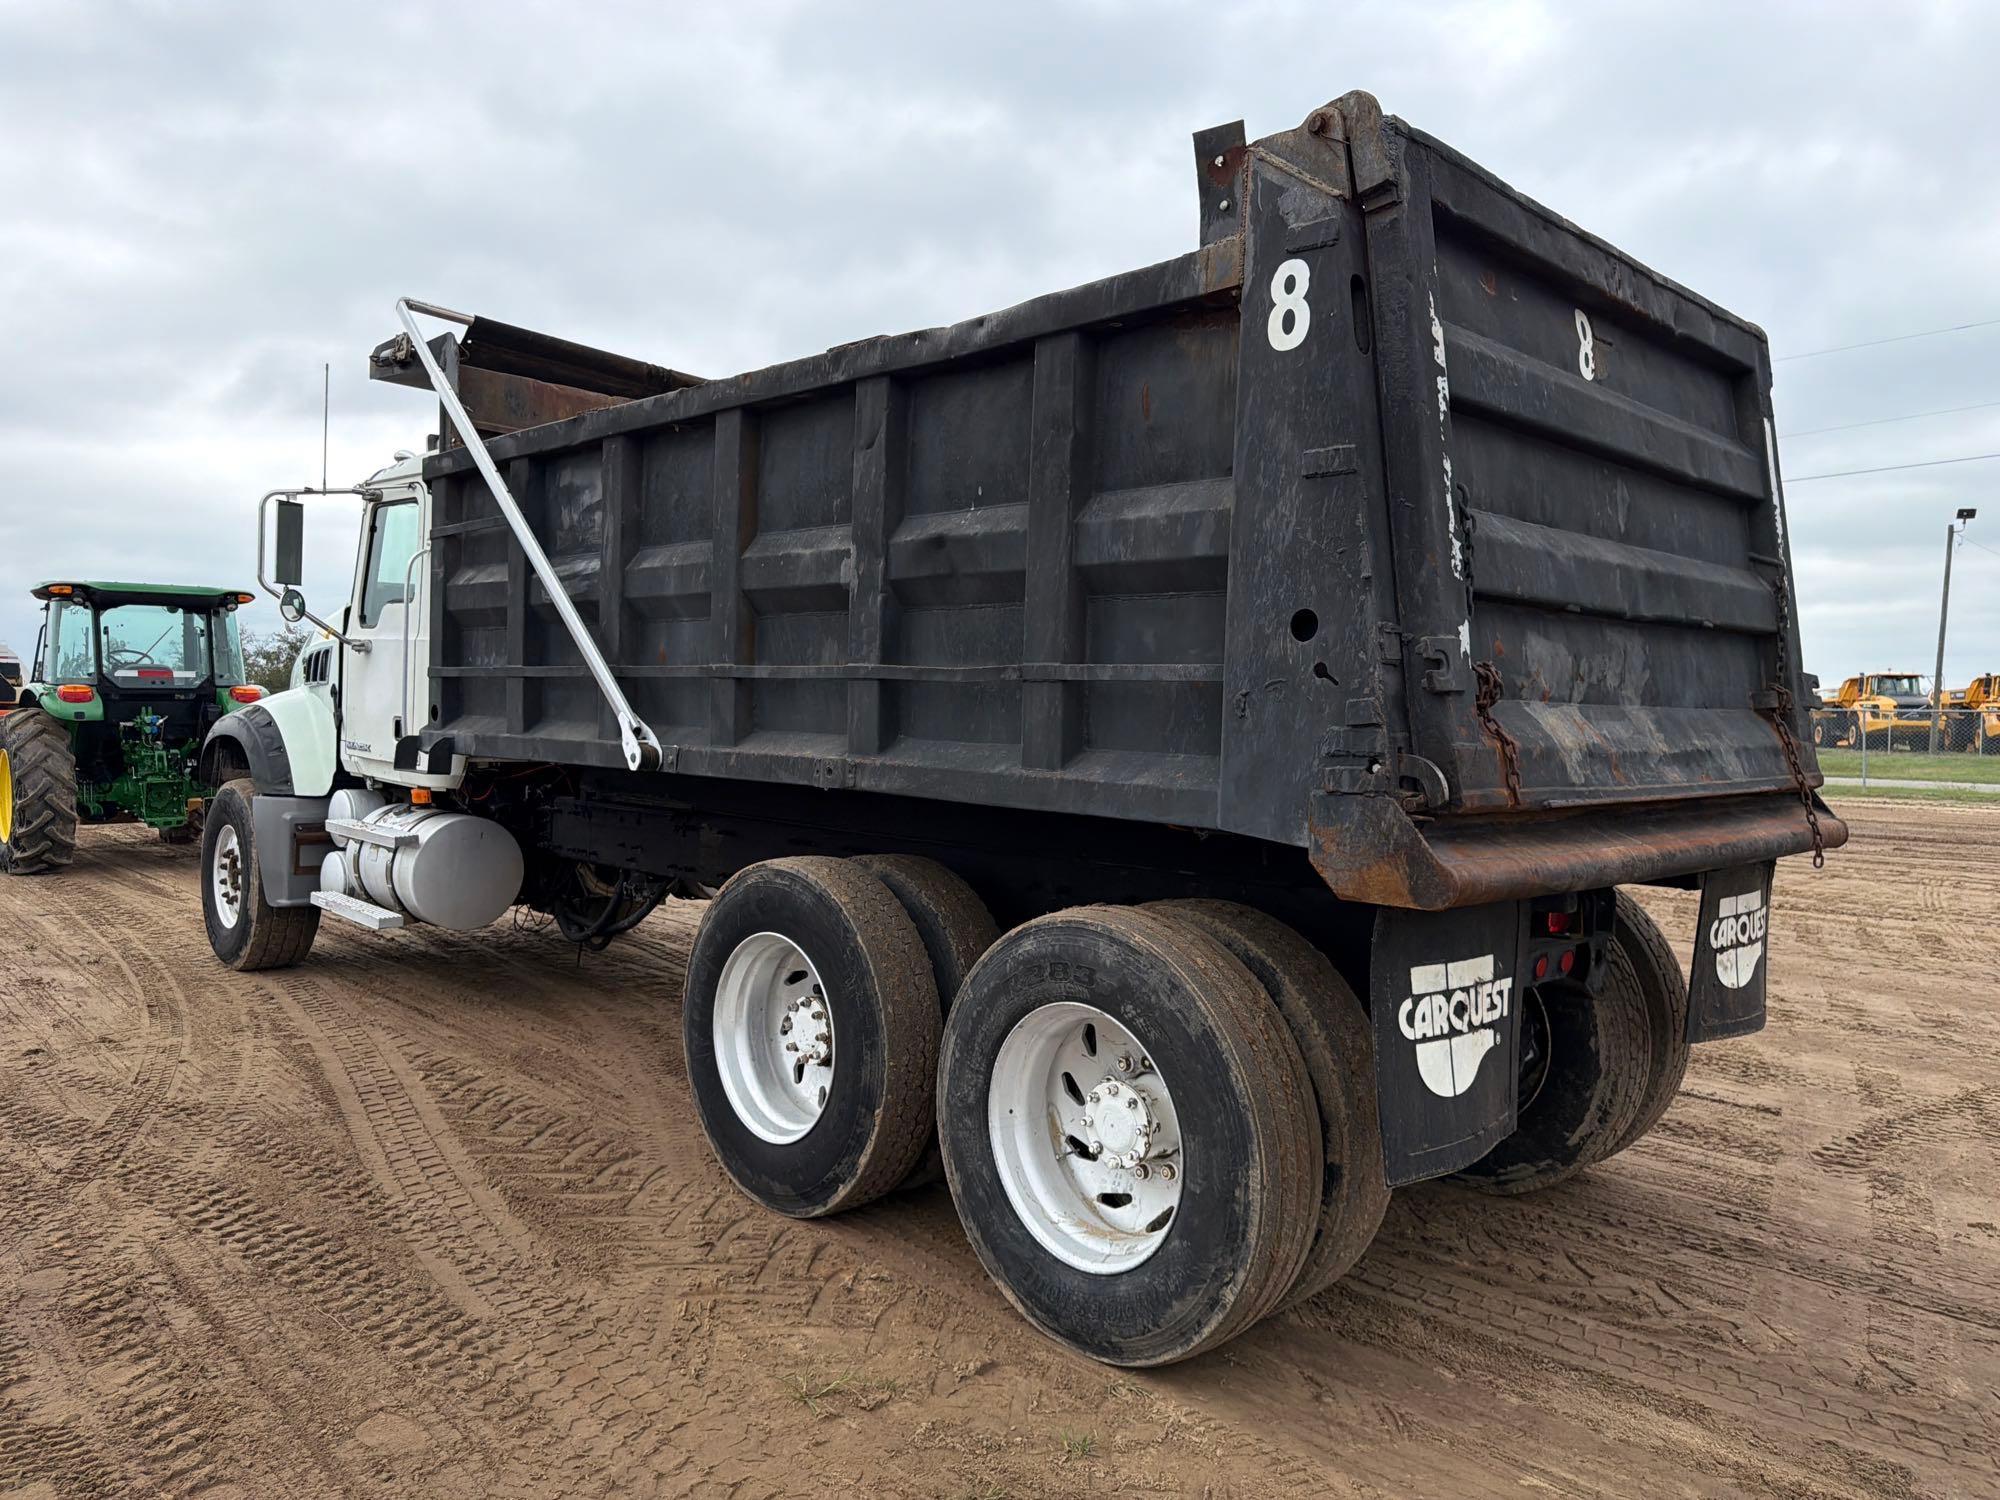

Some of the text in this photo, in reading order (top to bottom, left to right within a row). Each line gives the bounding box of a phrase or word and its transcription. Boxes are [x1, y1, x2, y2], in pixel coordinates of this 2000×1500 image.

[1267, 258, 1311, 352] 8
[1574, 308, 1596, 382] 8
[1398, 977, 1513, 1041] CARQUEST
